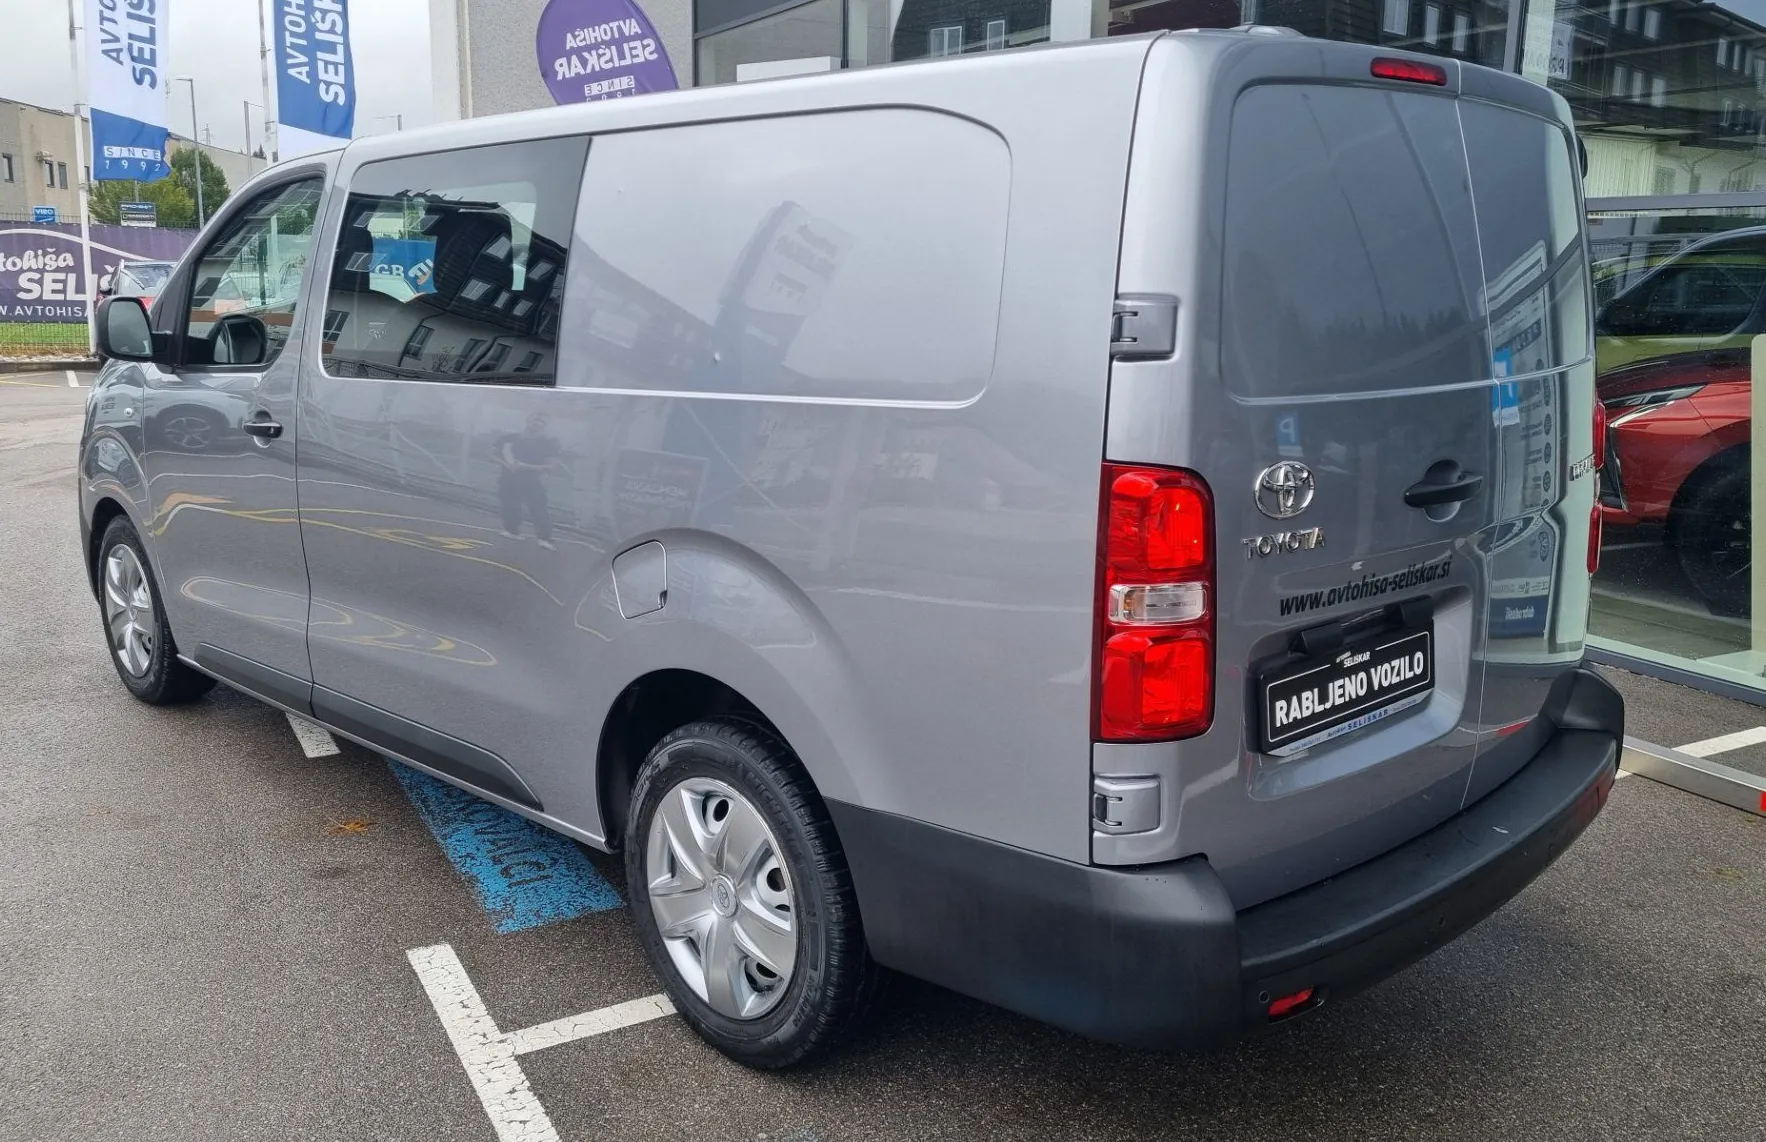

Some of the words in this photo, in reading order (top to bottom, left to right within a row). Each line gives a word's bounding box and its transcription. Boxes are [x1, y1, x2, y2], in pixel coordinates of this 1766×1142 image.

[105, 160, 161, 172] 1992
[106, 147, 160, 160] SINCE
[1242, 527, 1325, 559] TOYOTA
[1280, 553, 1453, 616] www.avtohisa-seliskar.si
[1275, 671, 1368, 728] RABLJENO
[1370, 651, 1424, 691] VOZILO
